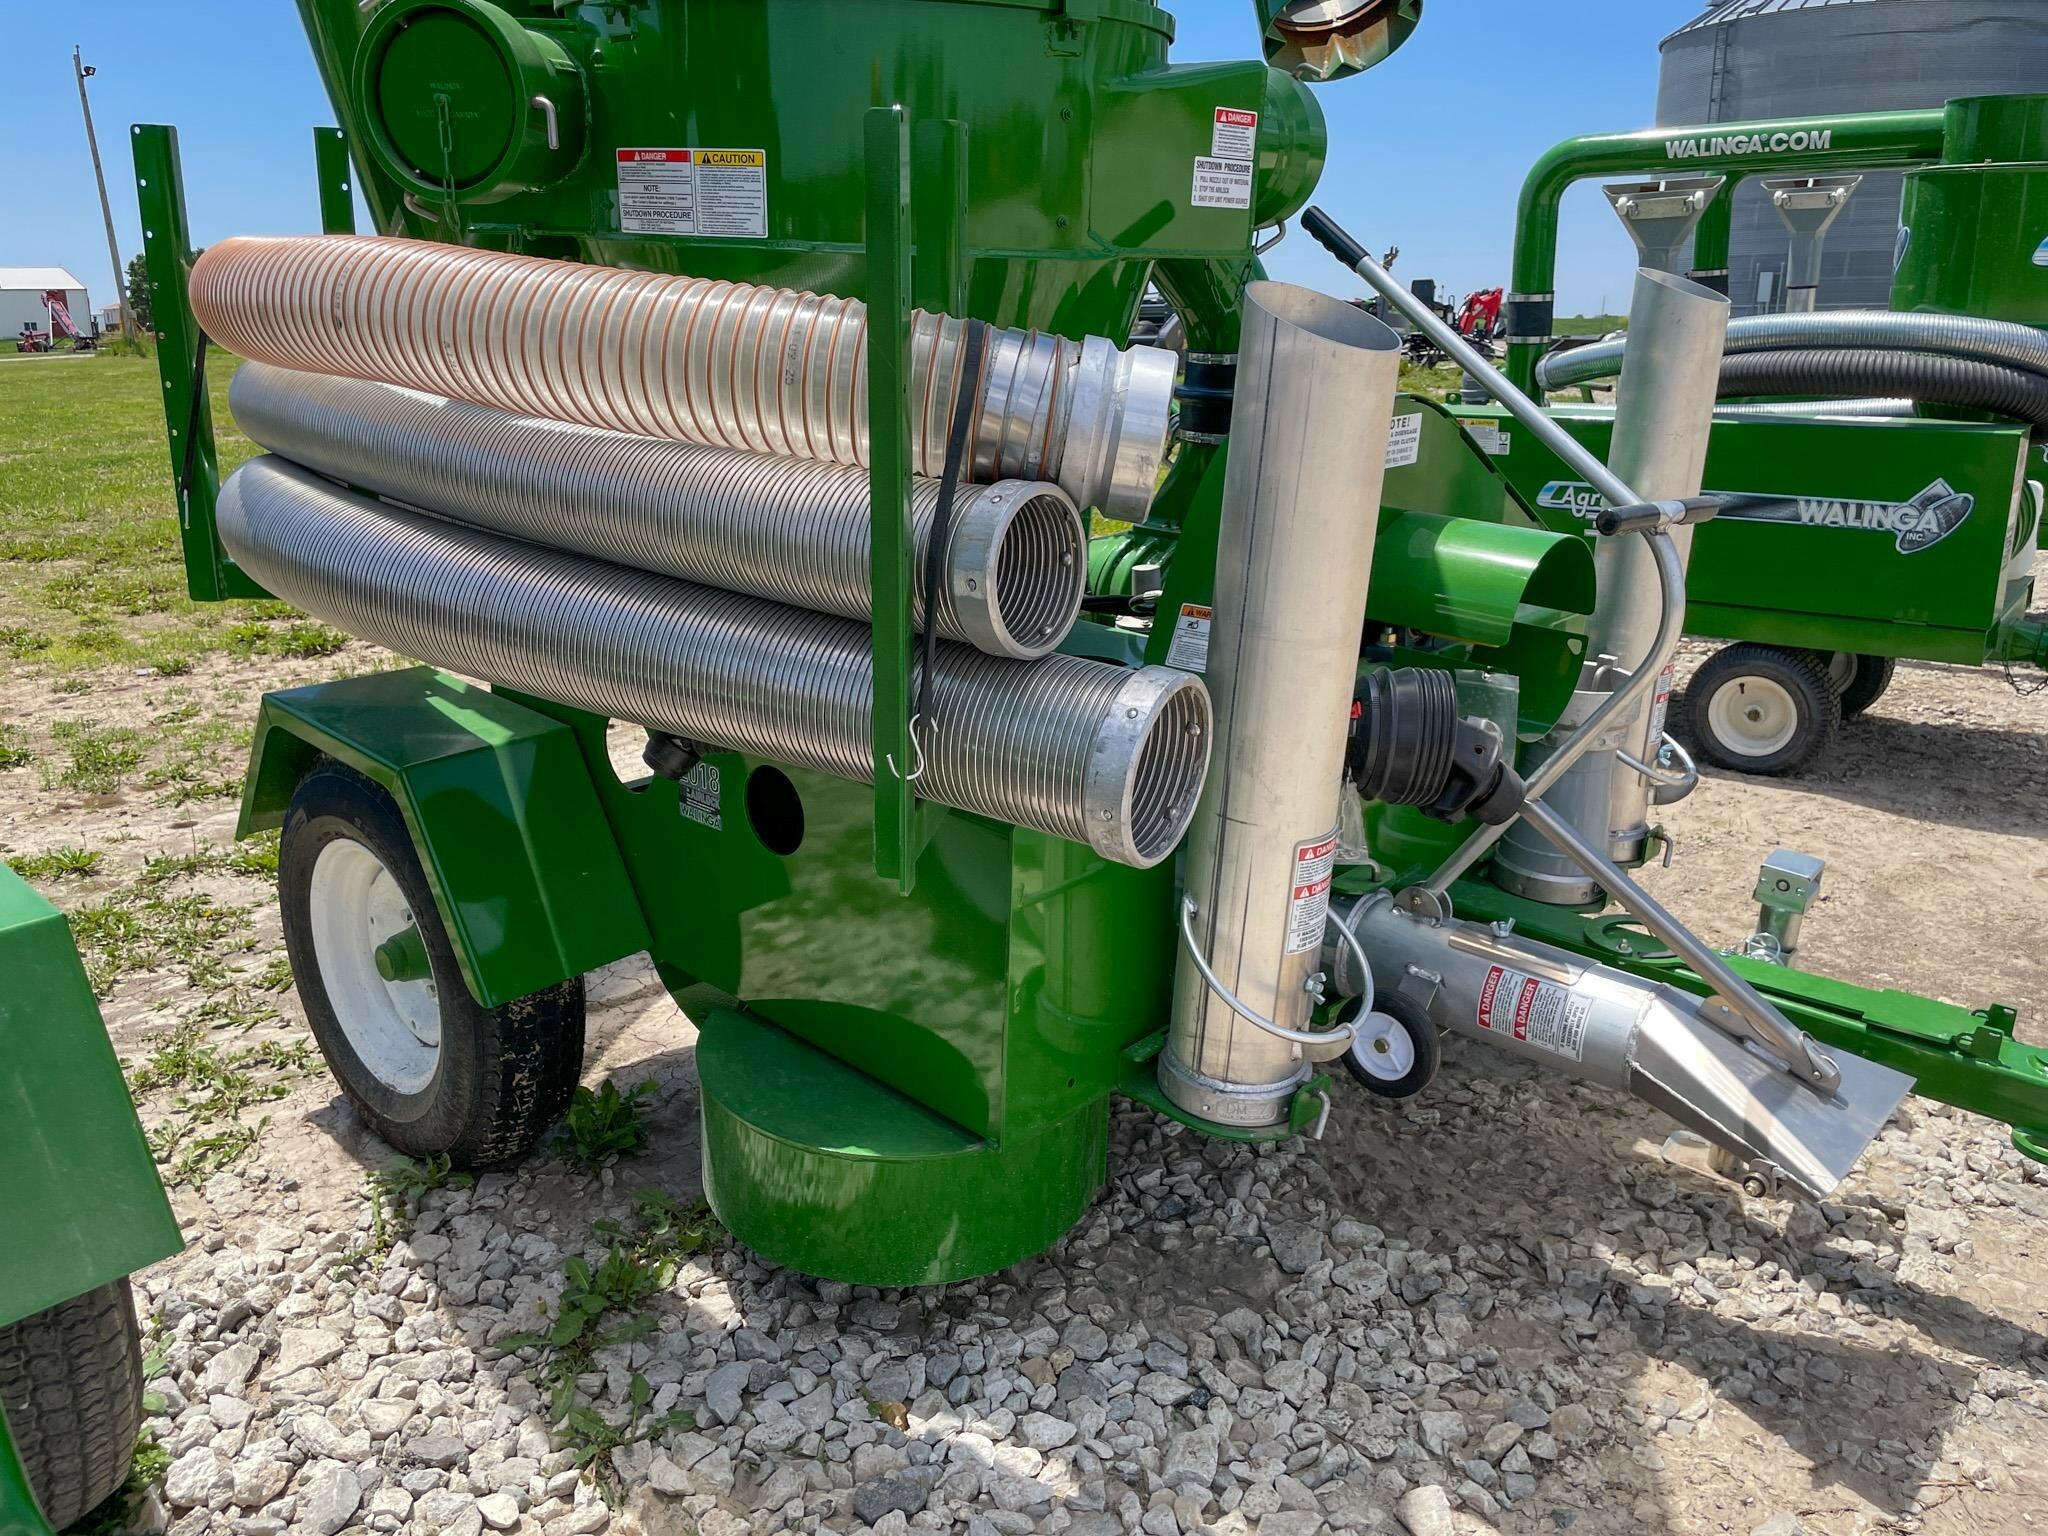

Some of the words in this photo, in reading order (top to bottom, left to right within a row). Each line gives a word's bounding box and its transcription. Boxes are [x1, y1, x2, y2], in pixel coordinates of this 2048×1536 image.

[1227, 112, 1252, 124] DANGER
[641, 152, 667, 160] DANGER
[712, 154, 755, 163] CAUTION
[1196, 160, 1222, 170] SHUTDOWN
[1224, 162, 1251, 173] PROCEDURE
[643, 184, 661, 192] NOTE:
[622, 209, 652, 217] SHUTDOWN
[653, 210, 692, 219] PROCEDURE
[1390, 416, 1410, 430] OTE!
[1798, 499, 1940, 533] WALINGA
[1906, 532, 1926, 542] INC.
[681, 803, 721, 828] WALINGA
[1484, 971, 1500, 1011] DANGER
[1520, 983, 1536, 1024] DANGER
